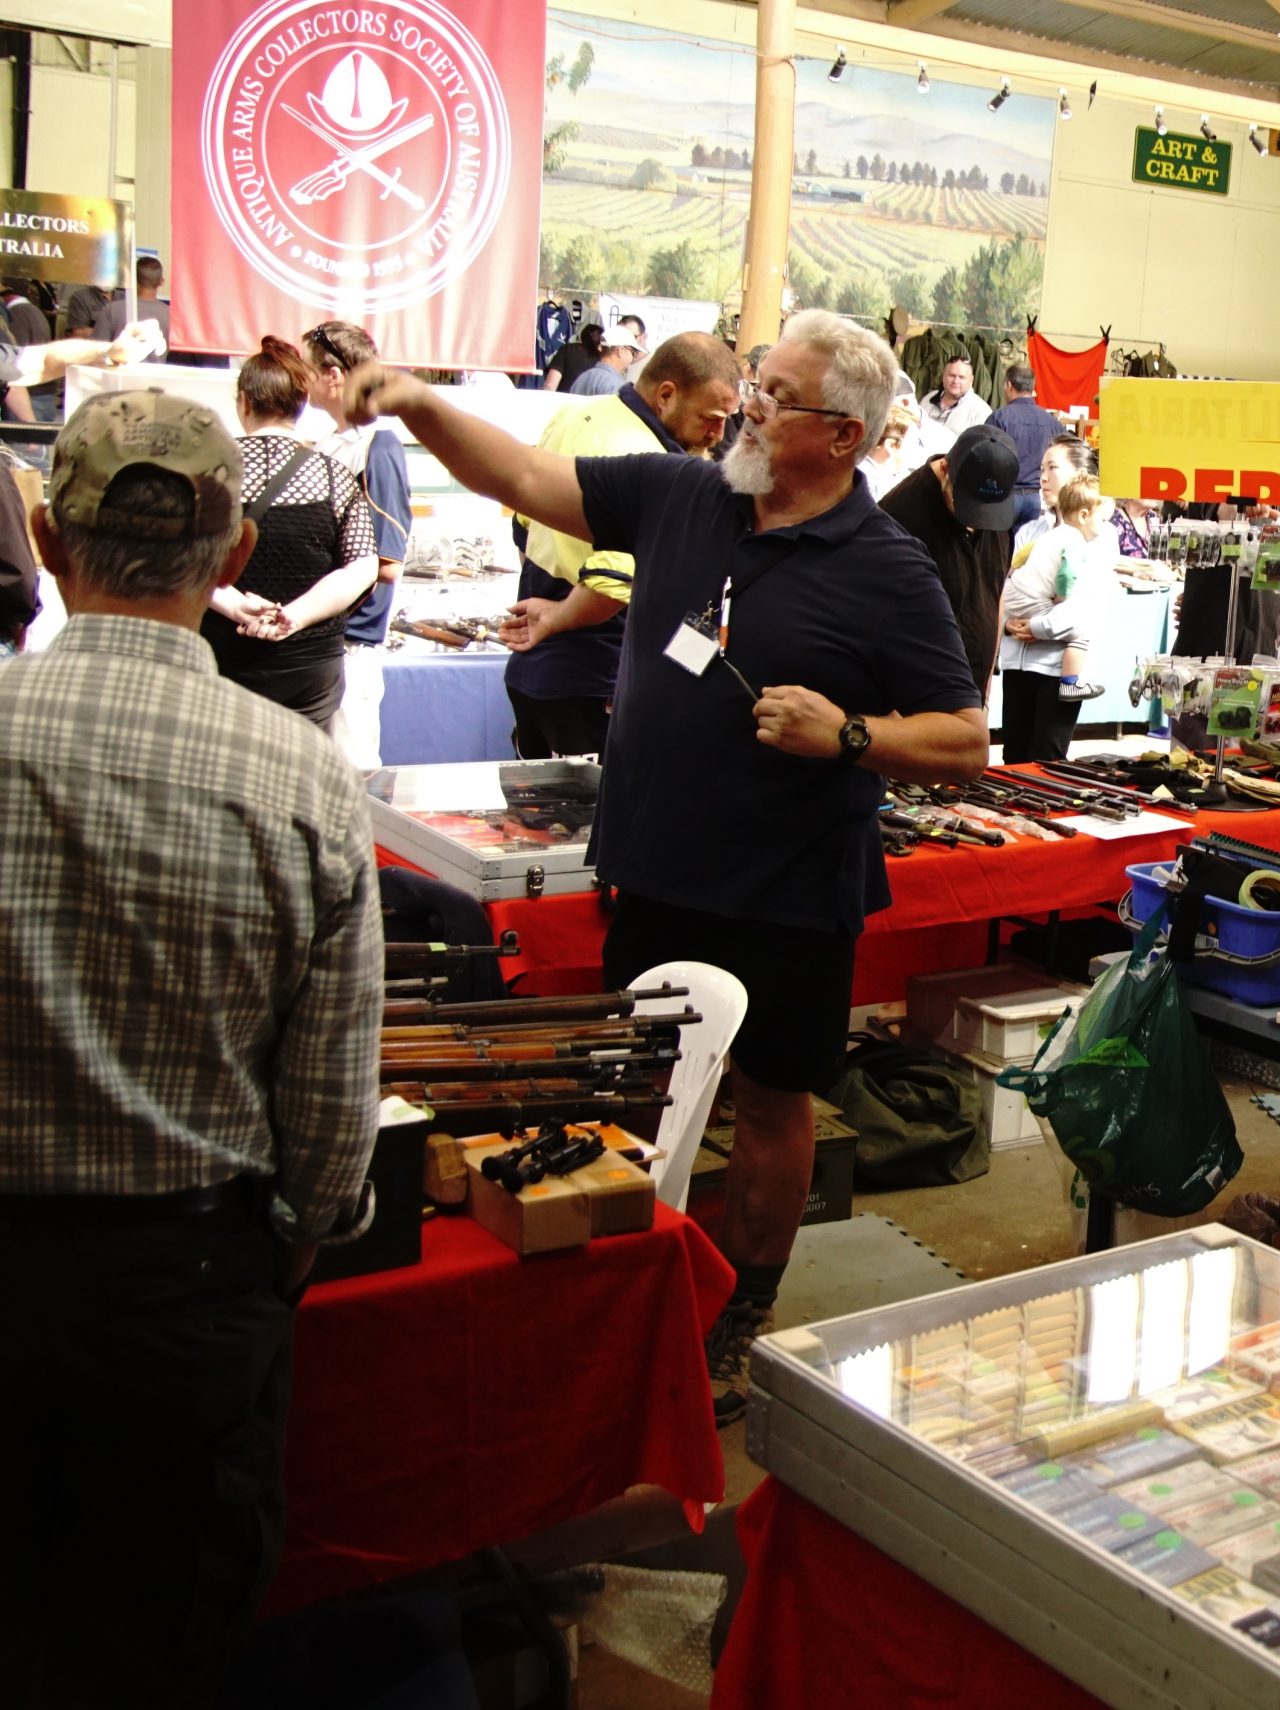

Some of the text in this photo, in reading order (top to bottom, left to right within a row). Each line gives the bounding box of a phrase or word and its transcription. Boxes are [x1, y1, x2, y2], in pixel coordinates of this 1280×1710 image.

[232, 9, 481, 257] ANTIQUE ARMS COLLECTORS SOCIETY OF AUSTRALIA
[1151, 138, 1218, 165] ART &
[1145, 159, 1219, 187] CRAFT
